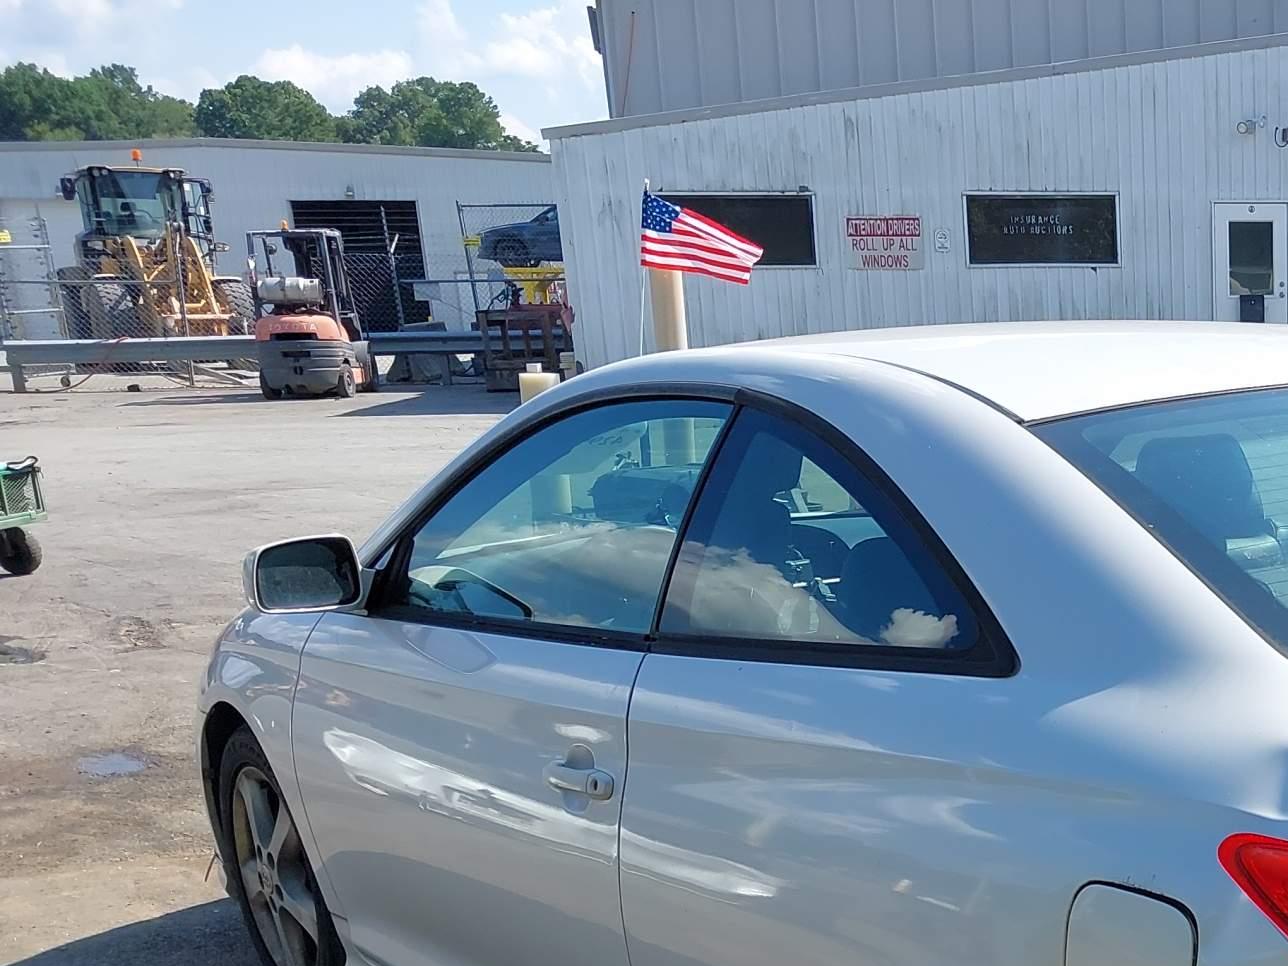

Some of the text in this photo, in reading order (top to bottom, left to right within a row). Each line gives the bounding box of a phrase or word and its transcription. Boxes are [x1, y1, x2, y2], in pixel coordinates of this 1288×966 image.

[1010, 214, 1060, 224] INSURANCE
[847, 220, 920, 235] ATTENTION DRIVERS
[852, 238, 918, 251] ROLL UP ALL
[861, 254, 909, 268] WINDOWS
